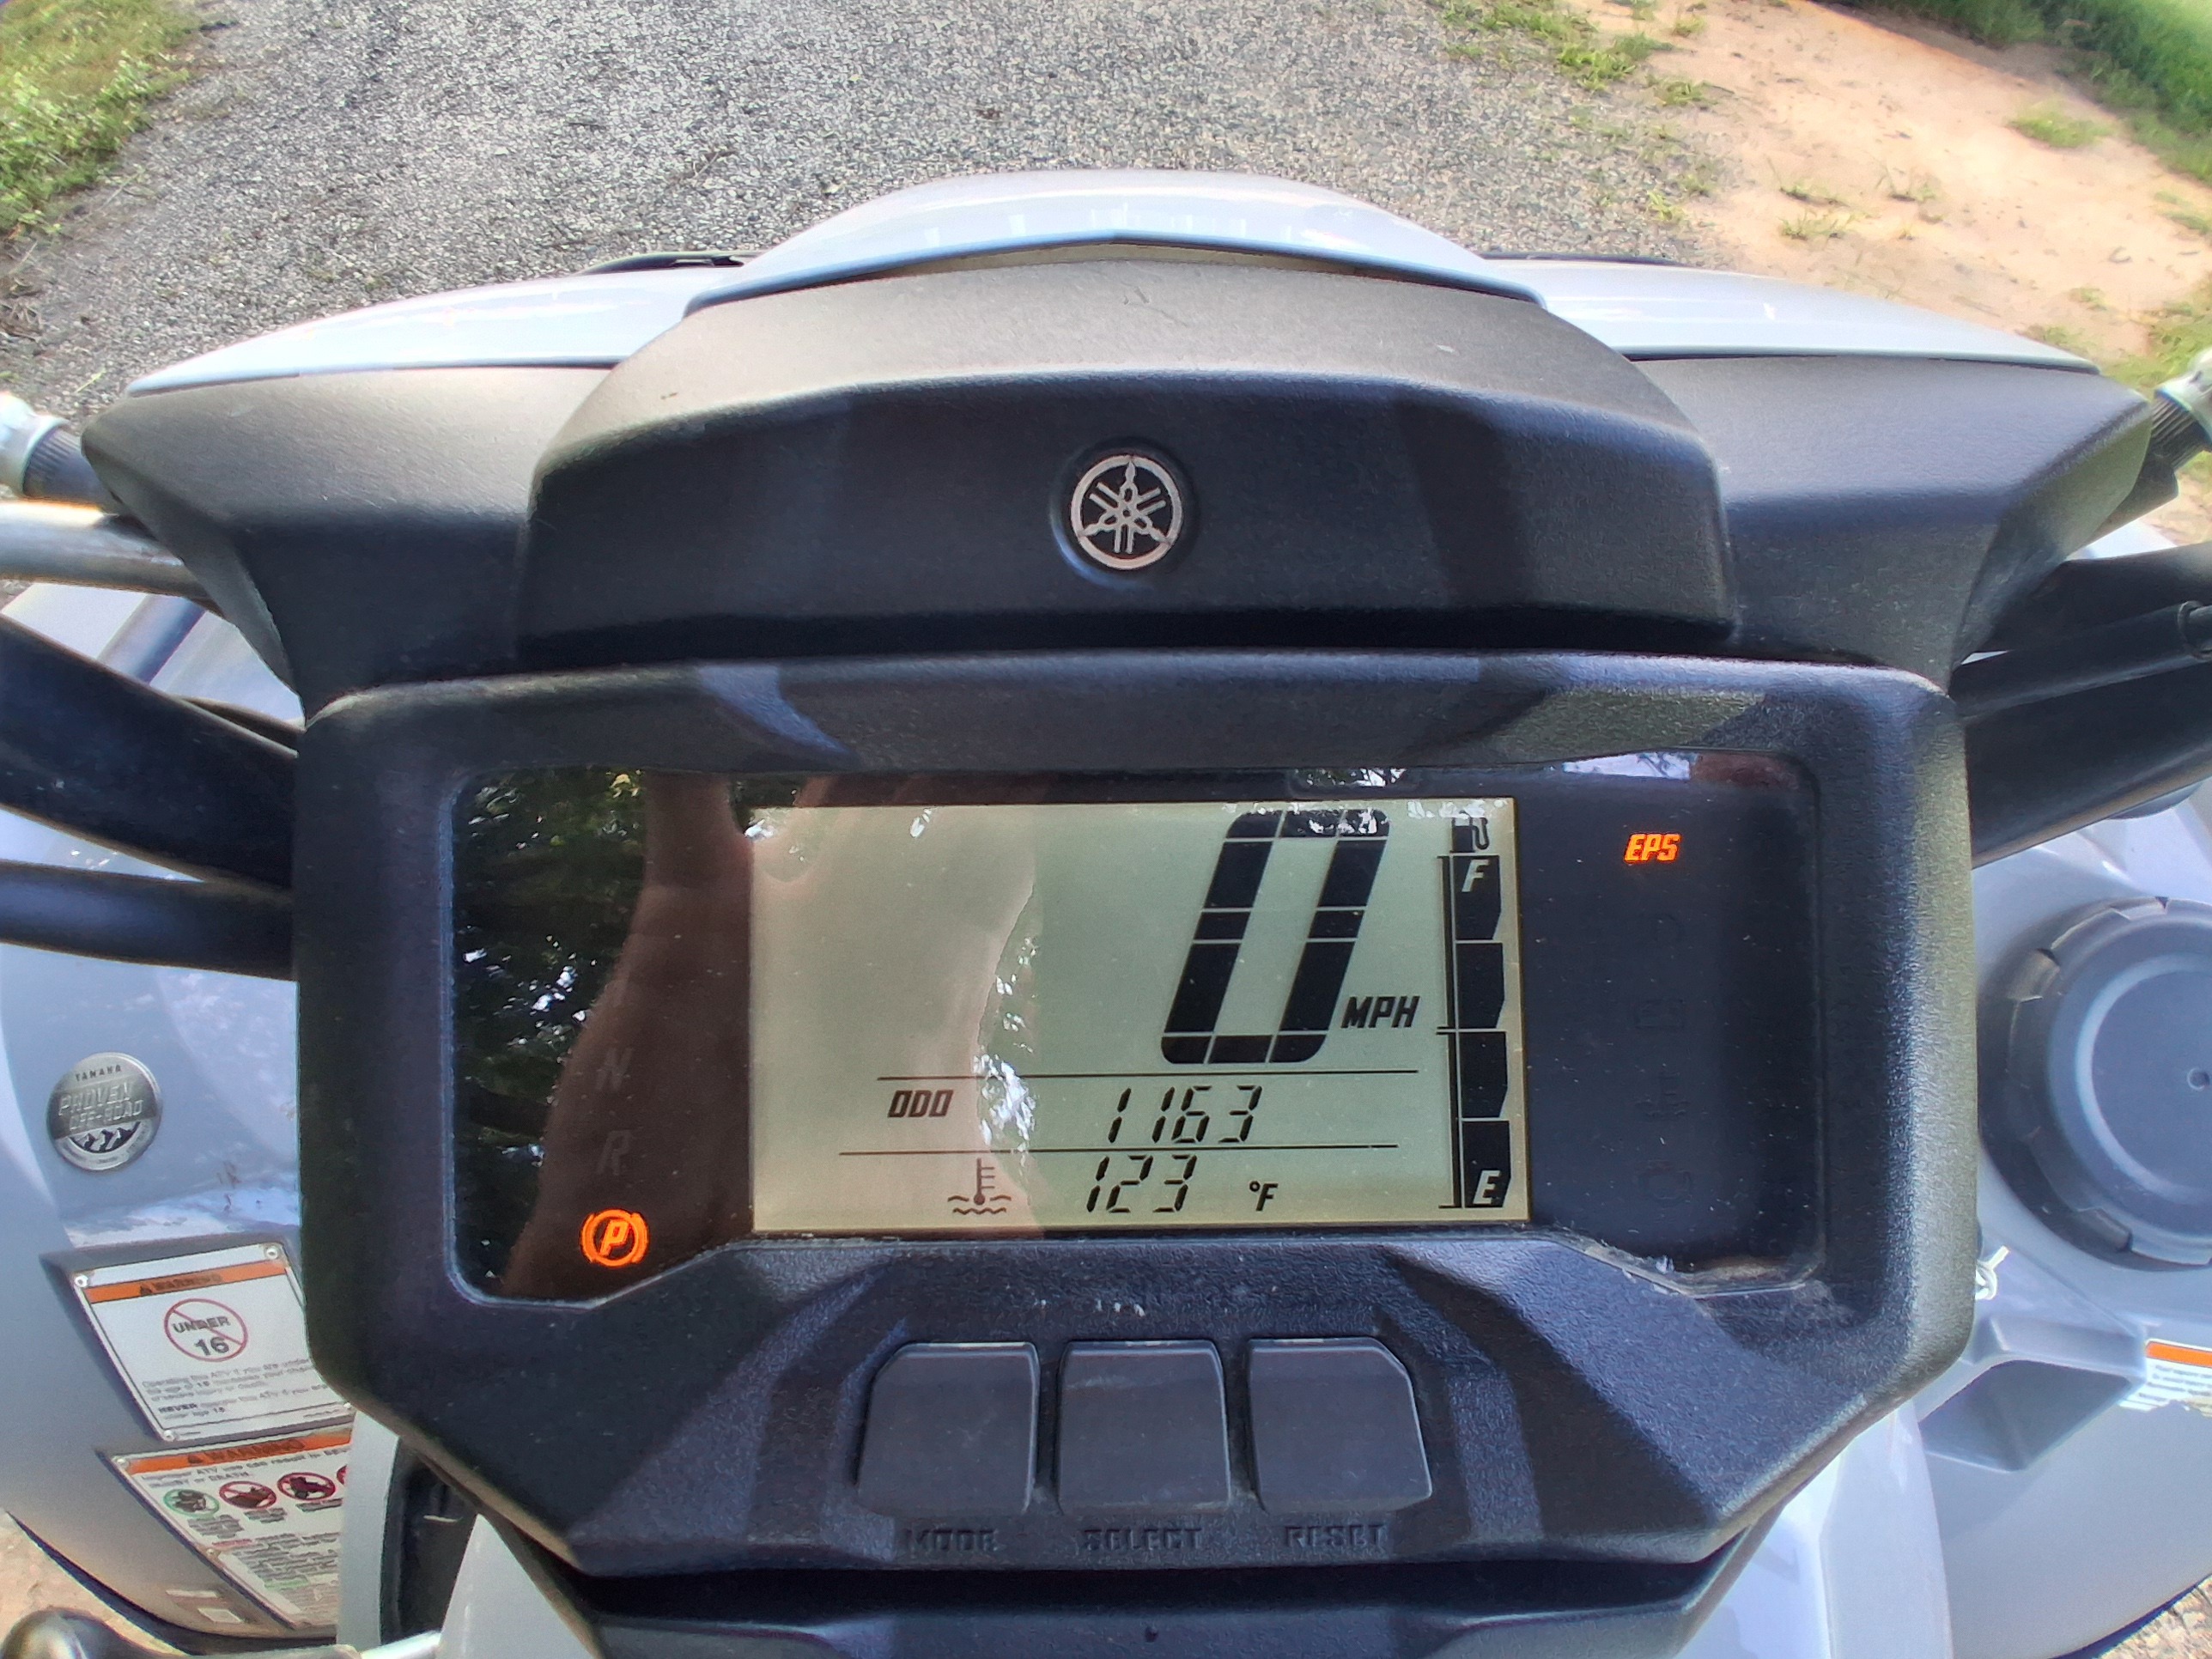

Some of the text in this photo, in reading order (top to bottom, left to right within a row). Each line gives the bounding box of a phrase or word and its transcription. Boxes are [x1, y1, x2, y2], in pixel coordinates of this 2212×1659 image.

[1623, 833, 1682, 862] EPS
[1462, 860, 1489, 892] F
[1161, 809, 1420, 1064] 0 MPH
[75, 1064, 122, 1082] YAMAHA
[887, 1085, 1263, 1144] ODO 1163
[1087, 1154, 1198, 1212] 123
[1473, 1170, 1500, 1205] E
[599, 1218, 632, 1257] P
[172, 1316, 232, 1334] UNDER
[194, 1336, 230, 1357] 16
[1084, 1528, 1202, 1551] SELECT
[1284, 1523, 1385, 1547] RESET
